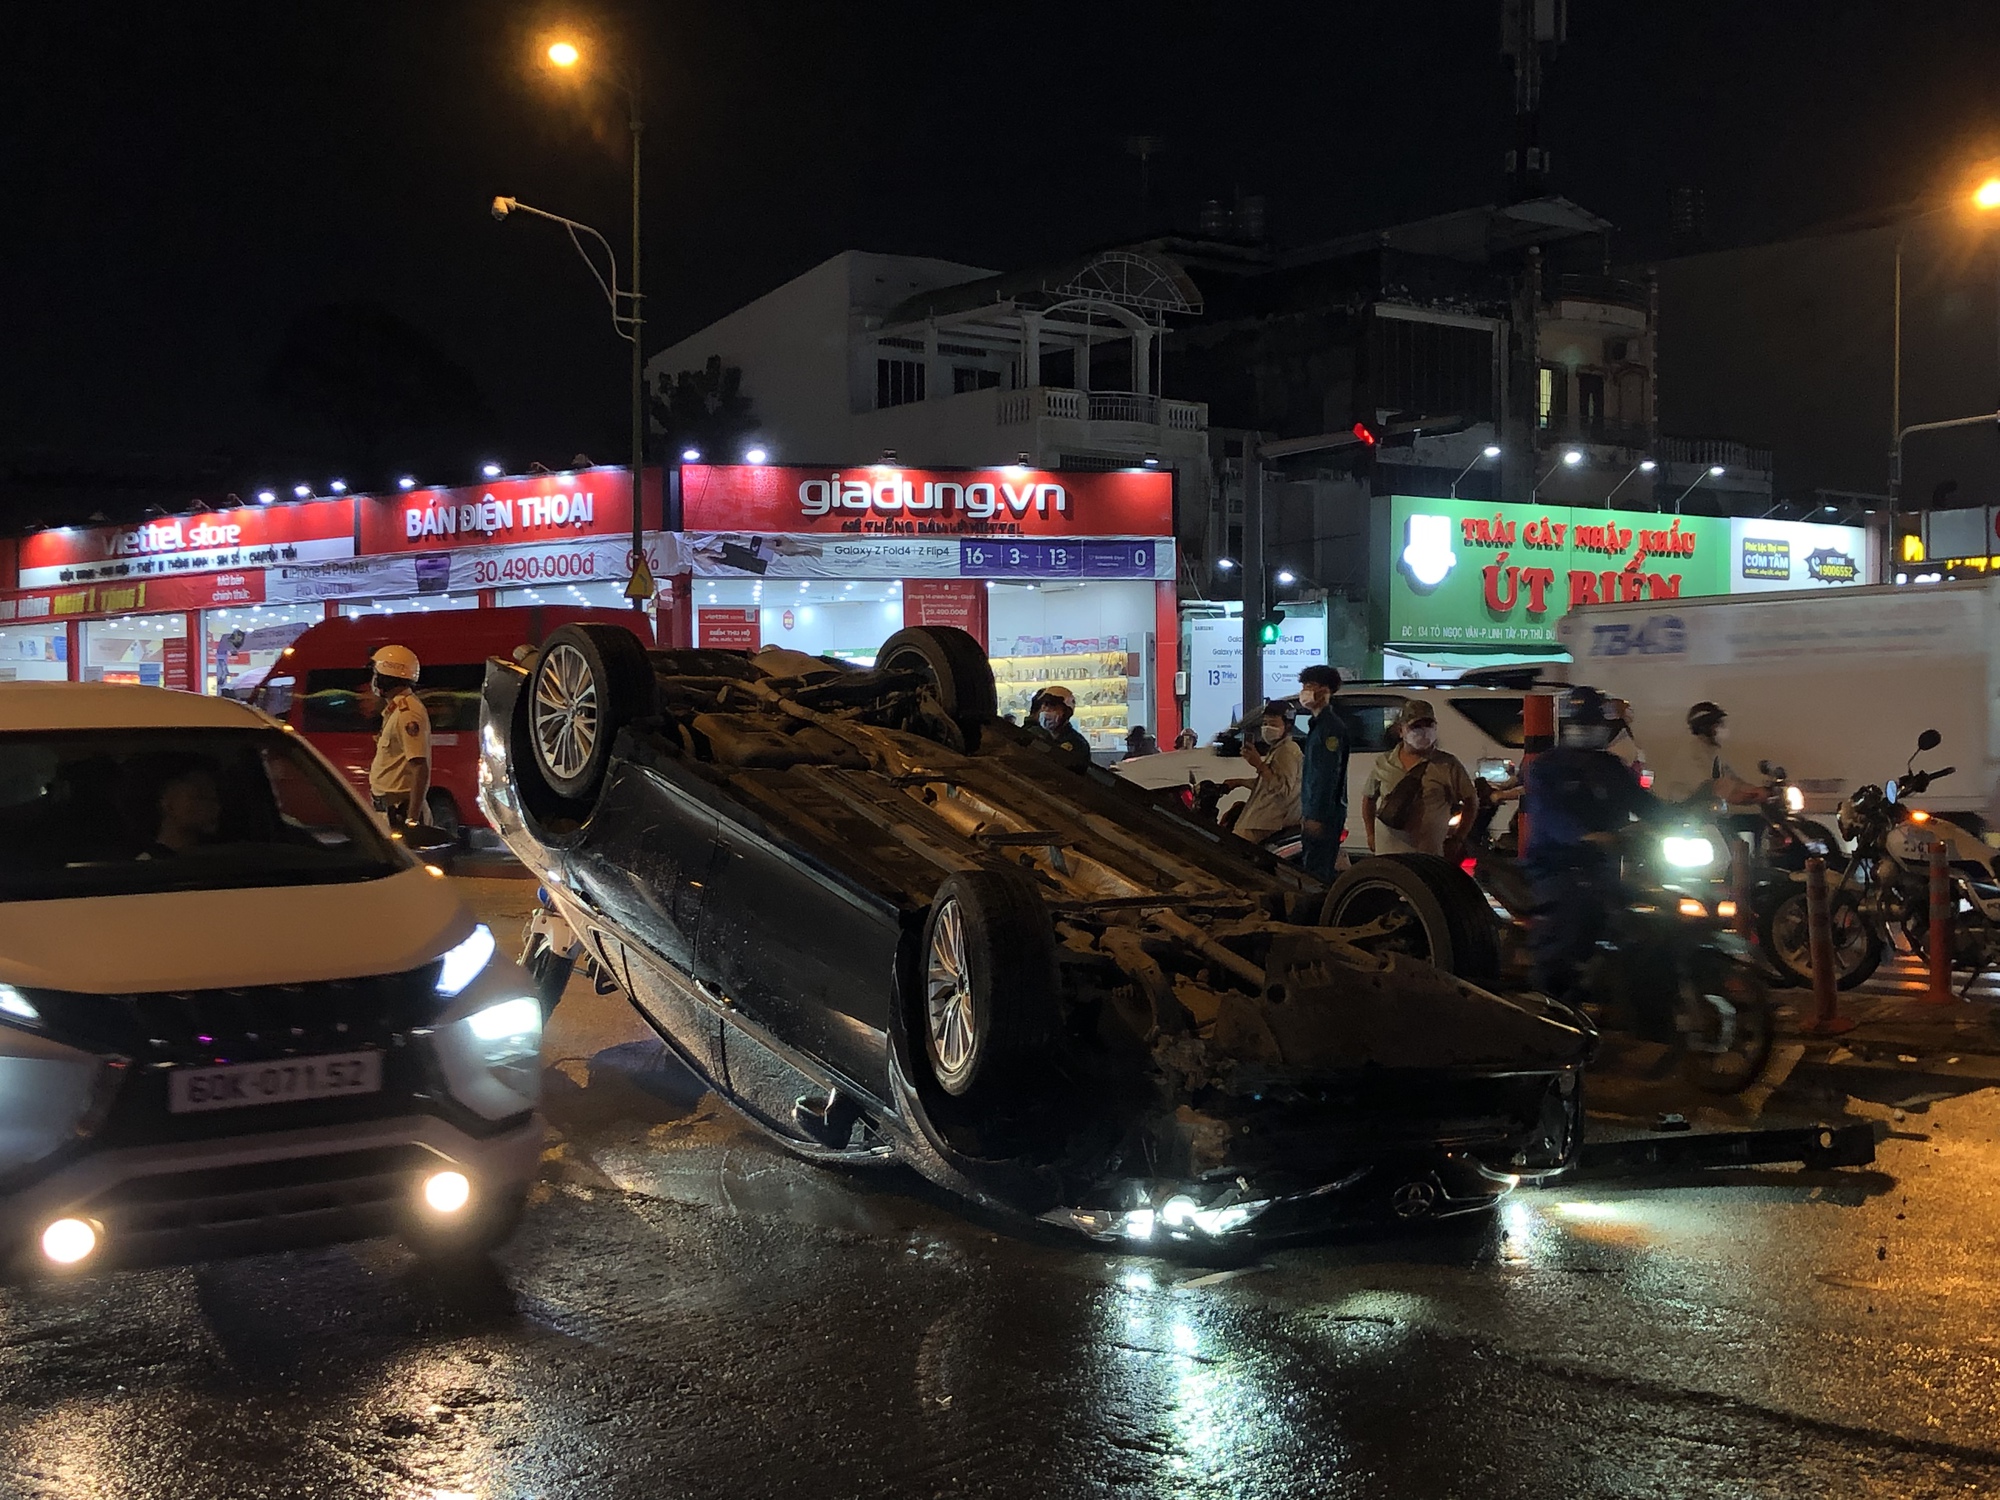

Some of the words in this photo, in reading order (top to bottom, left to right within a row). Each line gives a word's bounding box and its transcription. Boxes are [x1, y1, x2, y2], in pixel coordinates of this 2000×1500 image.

[799, 472, 1065, 518] giadung.vn
[406, 498, 456, 537] BÁN
[460, 493, 513, 537] ĐIỆN
[517, 492, 594, 529] THOẠI
[865, 515, 914, 533] THỐNG
[104, 521, 186, 556] viettel
[189, 522, 241, 547] store
[1462, 513, 1516, 543] TRÁI
[1523, 516, 1568, 546] CÂY
[1574, 520, 1632, 555] NHẬP
[1639, 518, 1696, 553] KHẨU
[834, 545, 872, 557] Galaxy
[875, 546, 881, 555] Z
[883, 545, 911, 556] Fold4
[918, 546, 924, 555] Z
[926, 546, 949, 558] Flip4
[965, 547, 984, 565] 16
[1009, 548, 1020, 564] 3
[1049, 548, 1067, 566] 13
[1134, 549, 1146, 566] 0
[349, 562, 370, 575] Max
[474, 552, 594, 583] 30.490.000đ
[1745, 553, 1767, 567] CƠM
[1769, 554, 1788, 569] TẤM
[1826, 556, 1846, 565] HOTLINE
[1819, 565, 1853, 577] 19006552
[1482, 552, 1554, 613] ÚT
[1212, 648, 1233, 656] Galaxy
[1208, 670, 1220, 686] 13
